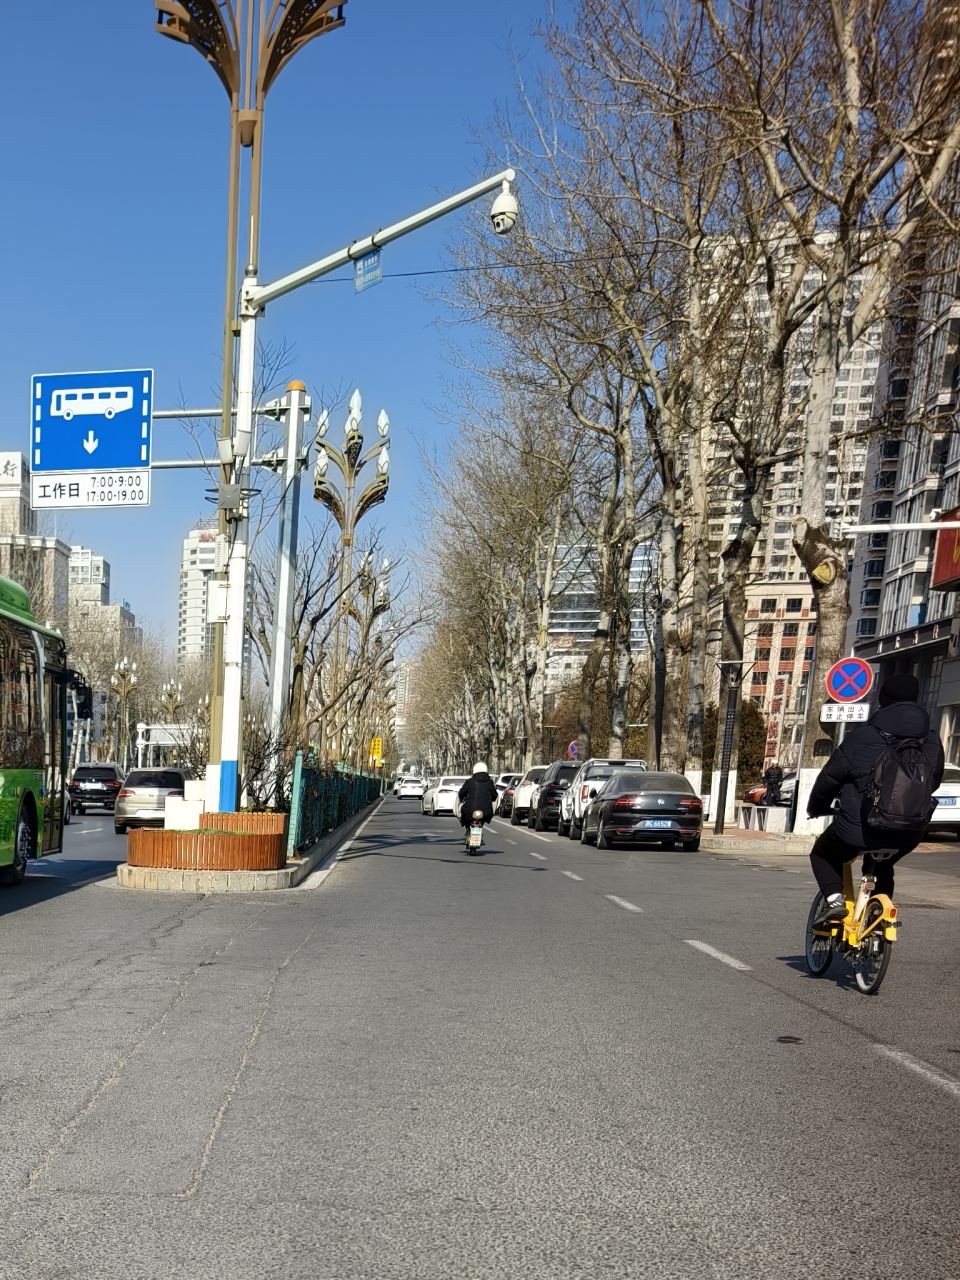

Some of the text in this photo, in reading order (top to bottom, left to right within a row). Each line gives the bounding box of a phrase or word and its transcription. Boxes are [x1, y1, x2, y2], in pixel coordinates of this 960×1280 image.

[38, 482, 80, 499] 工作日
[826, 705, 865, 713] 车辆出入
